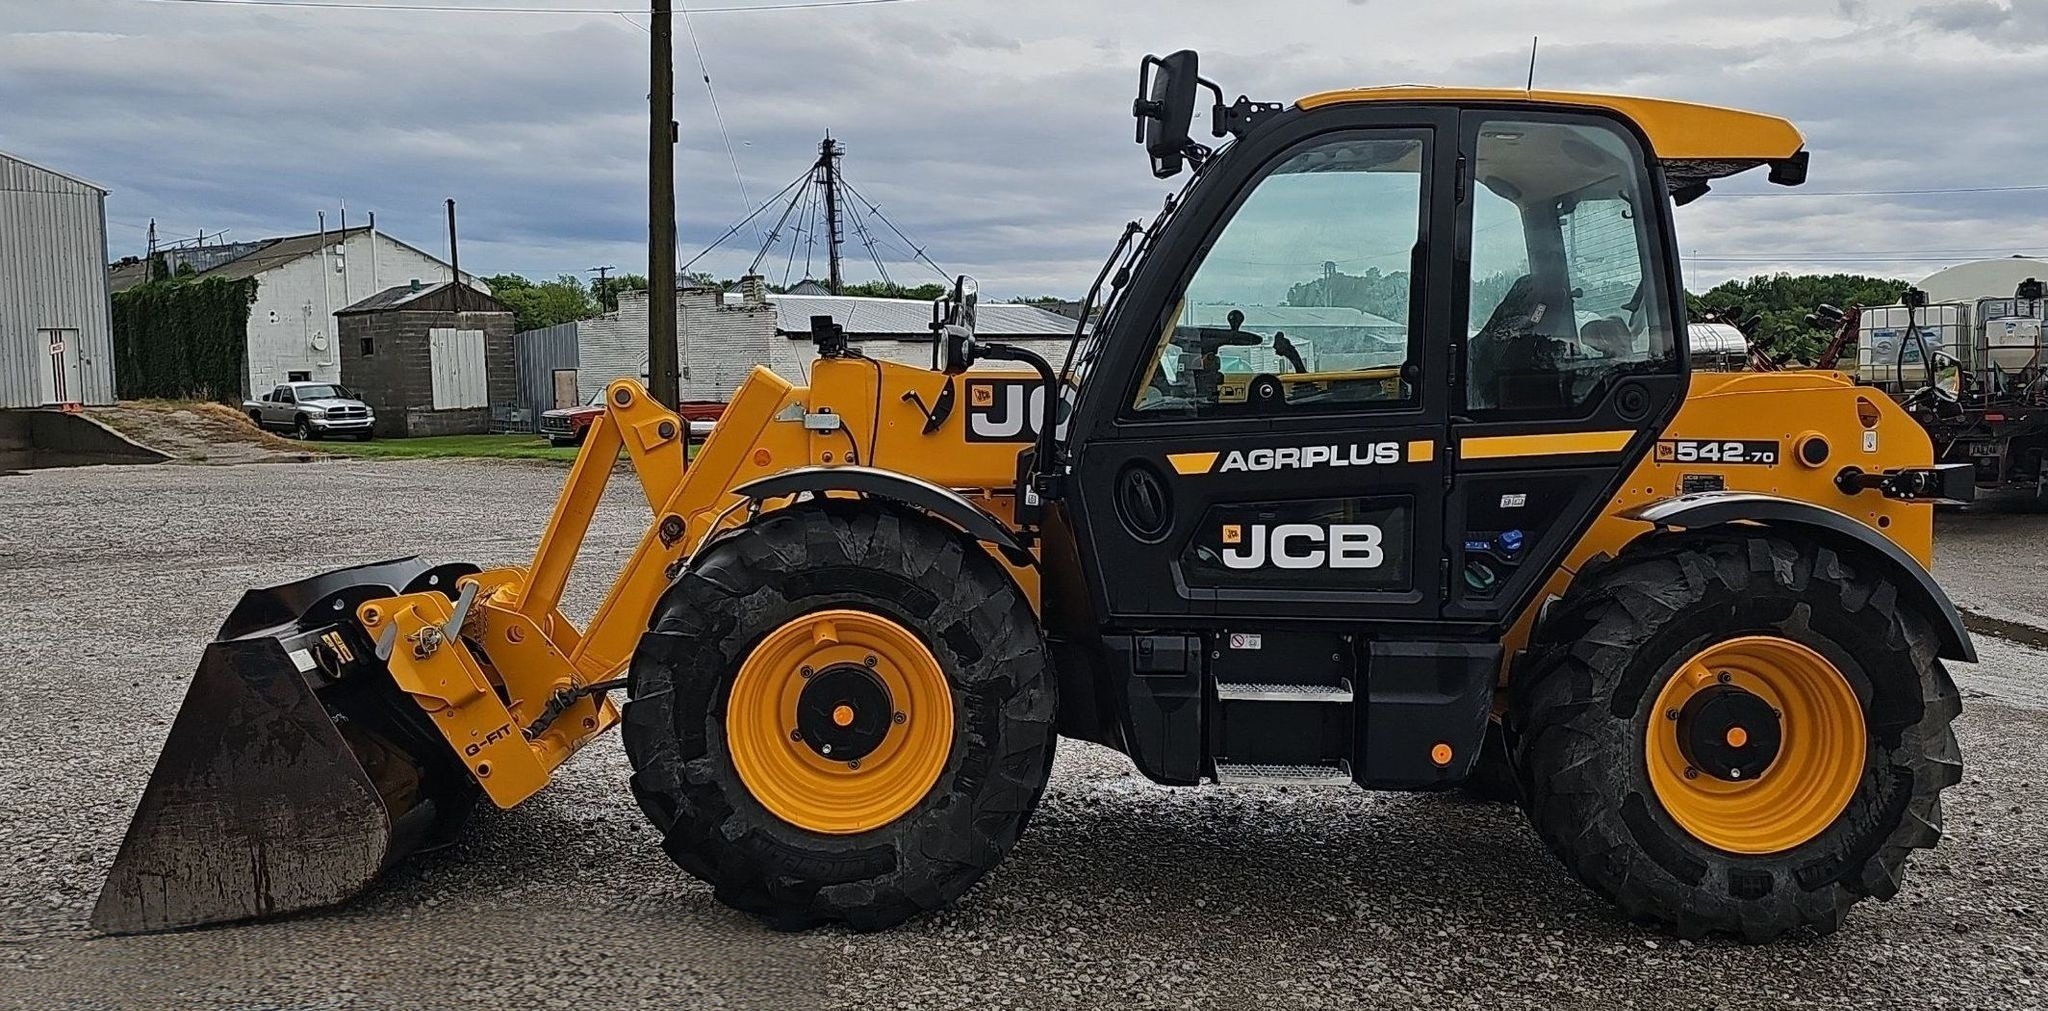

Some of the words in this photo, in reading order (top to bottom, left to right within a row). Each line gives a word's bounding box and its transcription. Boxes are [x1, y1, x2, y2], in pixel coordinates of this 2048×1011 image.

[1219, 441, 1400, 473] AGRIPLUS
[1676, 442, 1775, 463] 542-70
[1222, 524, 1384, 569] JCB
[465, 723, 511, 757] Q-FIT
